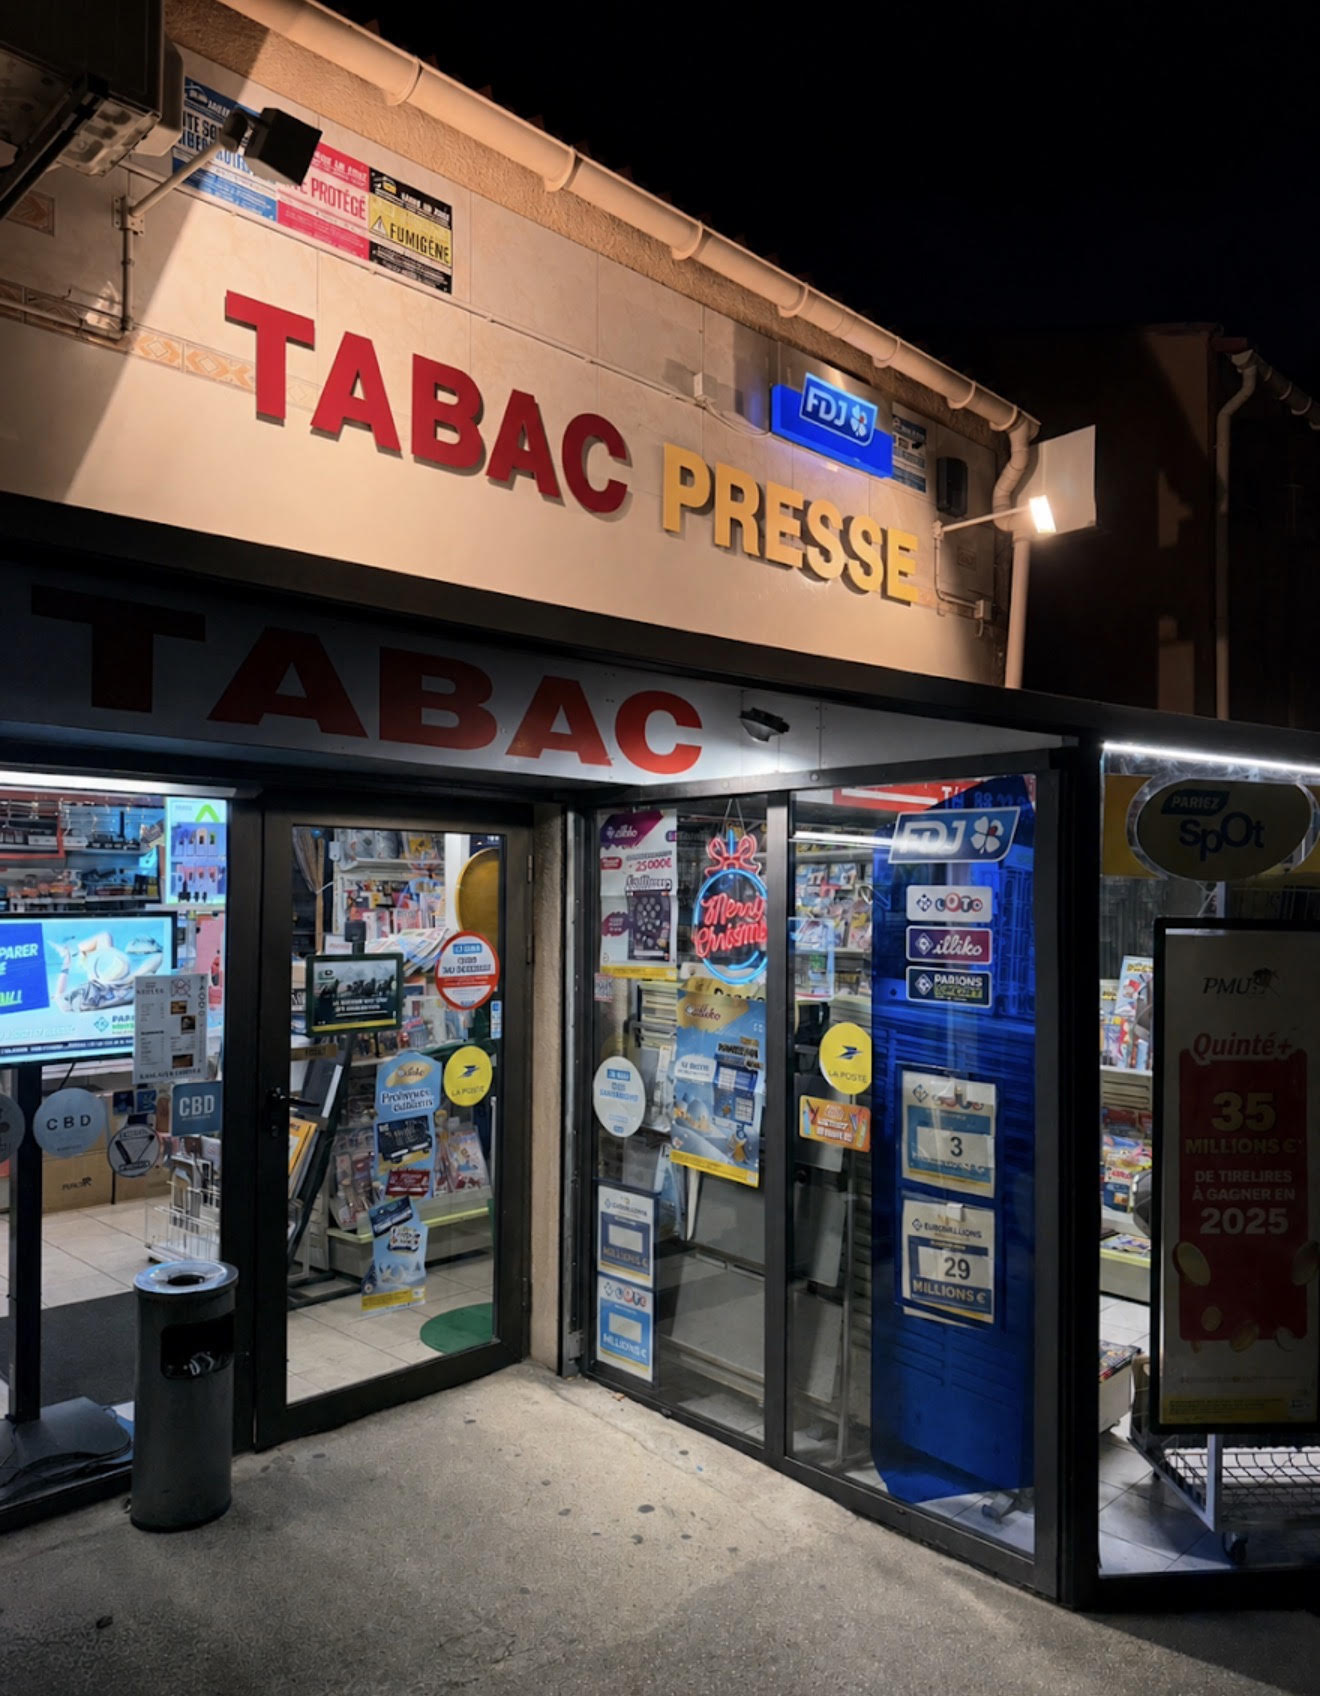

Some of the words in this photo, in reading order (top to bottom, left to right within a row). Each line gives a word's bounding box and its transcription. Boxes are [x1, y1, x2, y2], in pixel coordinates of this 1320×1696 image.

[311, 177, 366, 221] PROTÉGÉ
[805, 386, 848, 427] FDJ
[225, 289, 630, 515] TABAC
[662, 442, 919, 603] PRESSE
[30, 584, 704, 775] TABAC
[1170, 796, 1220, 810] PARIEZ
[900, 820, 966, 855] FDJ
[700, 893, 766, 926] Merry
[935, 892, 983, 912] LOTO
[932, 934, 983, 956] illiko
[934, 973, 983, 987] PARIONS
[1202, 977, 1251, 995] PMU
[1192, 1032, 1293, 1059] Quinté+
[839, 1072, 868, 1084] POSTE
[179, 1094, 215, 1117] CBD
[1210, 1090, 1277, 1133] 35
[46, 1114, 92, 1131] CBD
[950, 1136, 963, 1158] 3
[1184, 1138, 1280, 1155] MILLIONS
[1194, 1170, 1214, 1183] DE
[1218, 1170, 1293, 1183] TIRELIRES
[1192, 1185, 1204, 1201] À
[1206, 1187, 1272, 1201] GAGNER
[1274, 1187, 1296, 1201] EN
[924, 1223, 983, 1239] EUROMILLIONS
[1199, 1207, 1289, 1235] 2025
[944, 1256, 971, 1280] 29
[912, 1280, 974, 1302] MILLIONS
[976, 1292, 987, 1304] €
